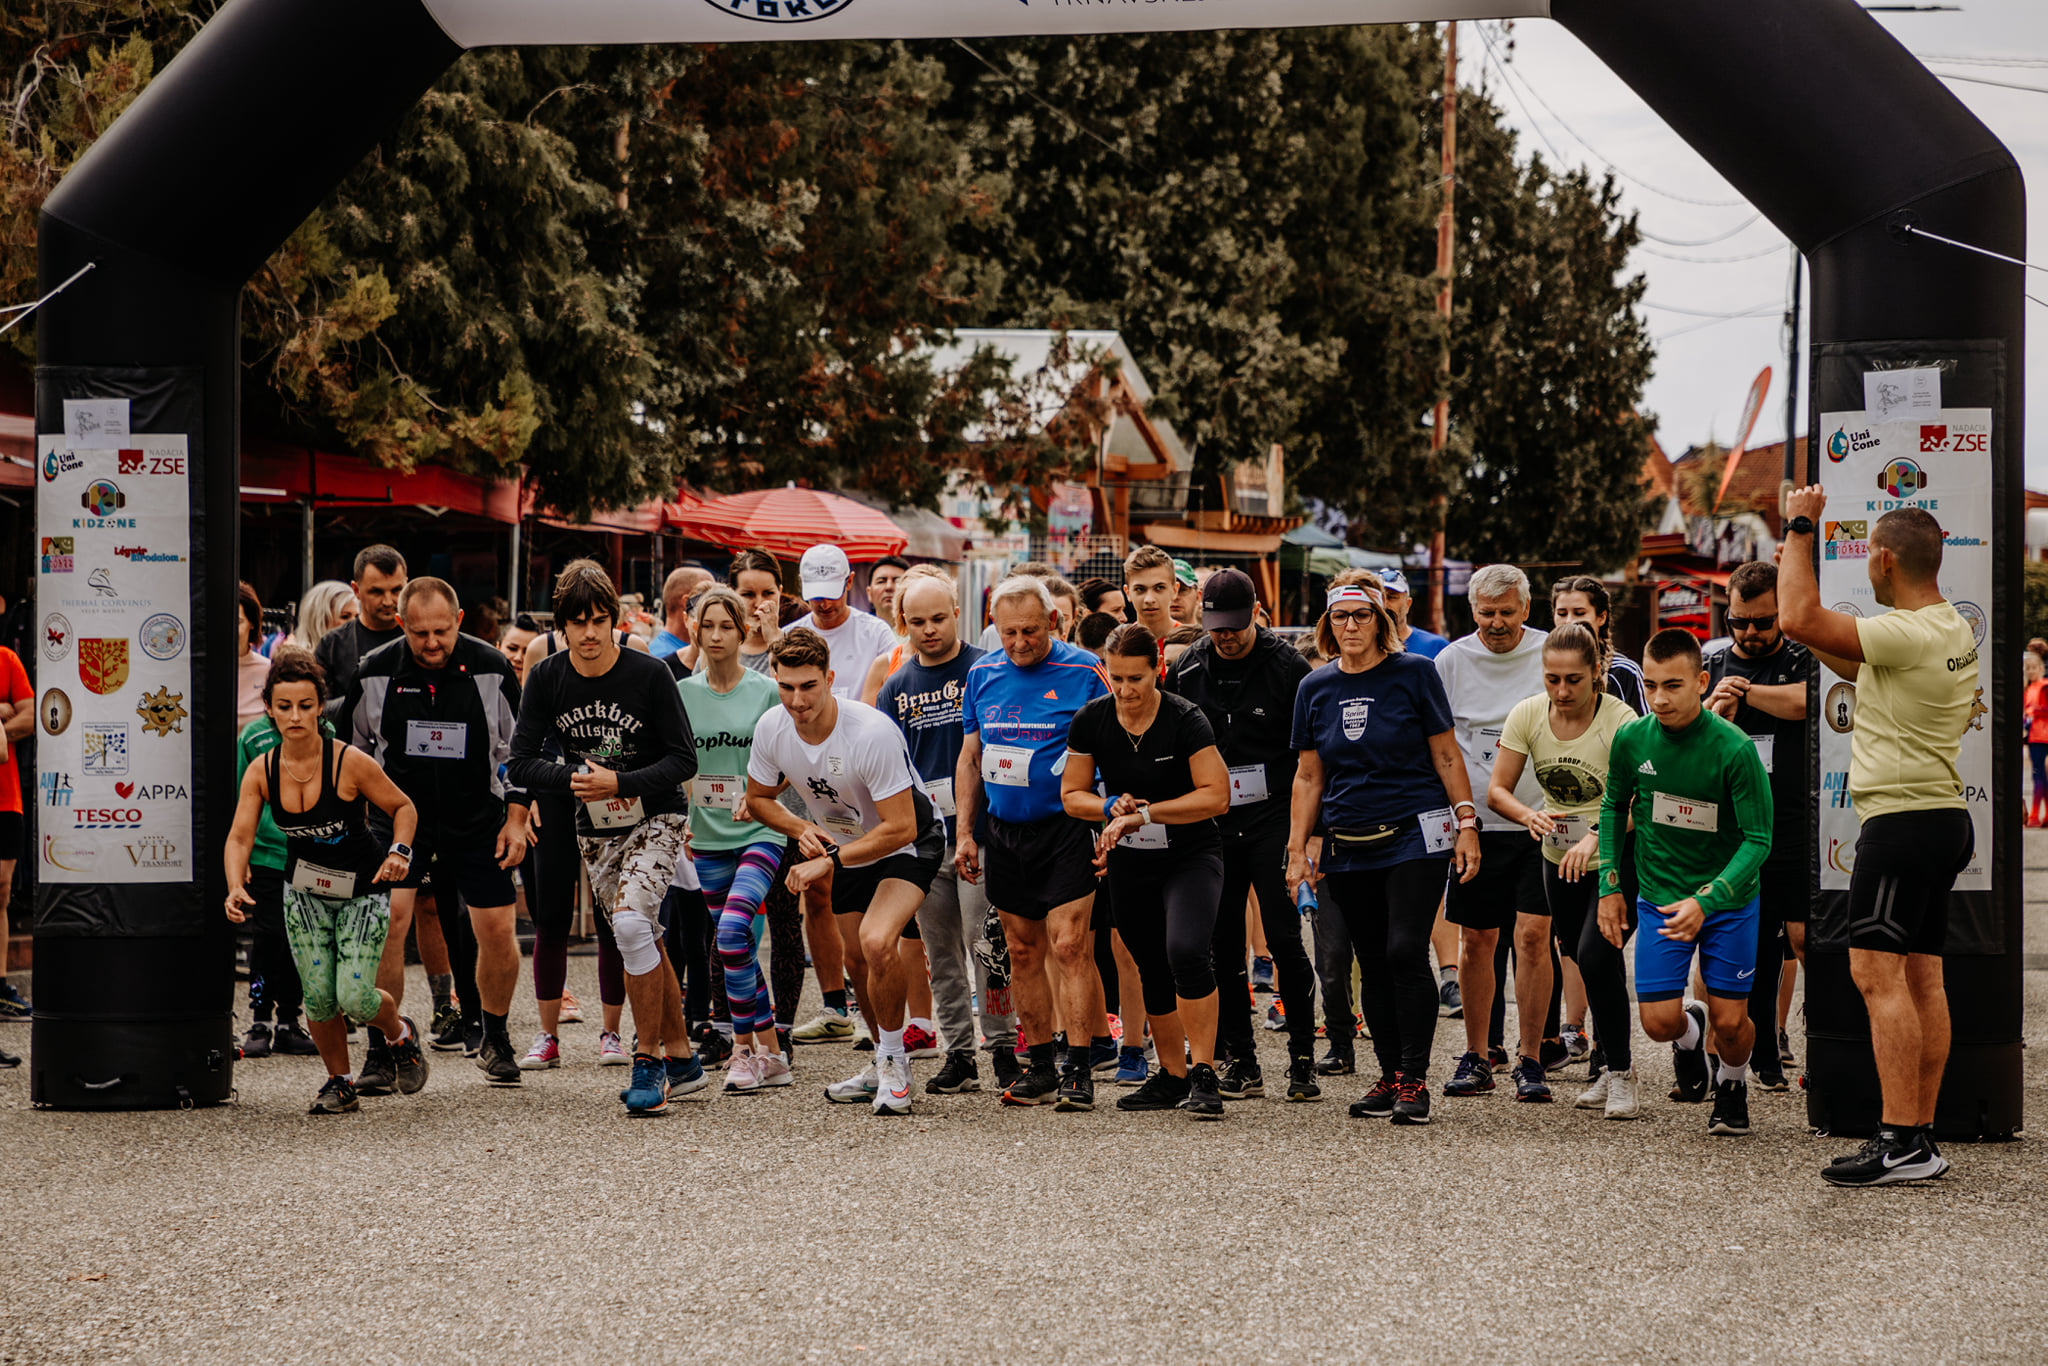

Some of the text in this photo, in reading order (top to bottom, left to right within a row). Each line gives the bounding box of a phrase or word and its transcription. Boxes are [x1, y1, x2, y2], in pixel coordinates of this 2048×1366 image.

[1850, 429, 1871, 442] Uni
[1852, 438, 1881, 452] Cone
[1952, 434, 1988, 452] ZSE
[59, 451, 76, 464] Uni
[60, 459, 84, 473] Cone
[149, 458, 186, 475] ZSE
[61, 599, 152, 608] THERMAL CORVINUS
[1344, 709, 1366, 718] Sprint
[430, 731, 443, 741] 23
[570, 724, 623, 738] allstar
[998, 758, 1013, 769] 106
[1558, 757, 1581, 766] GROUP
[136, 784, 189, 800] APPA
[710, 783, 725, 793] 119
[605, 801, 621, 812] 113
[1678, 805, 1693, 815] 117
[73, 808, 143, 823] TESCO
[124, 845, 176, 868] VIP
[142, 860, 183, 868] TRANSPORT
[316, 878, 331, 889] 118
[987, 988, 1015, 1014] ANGR
